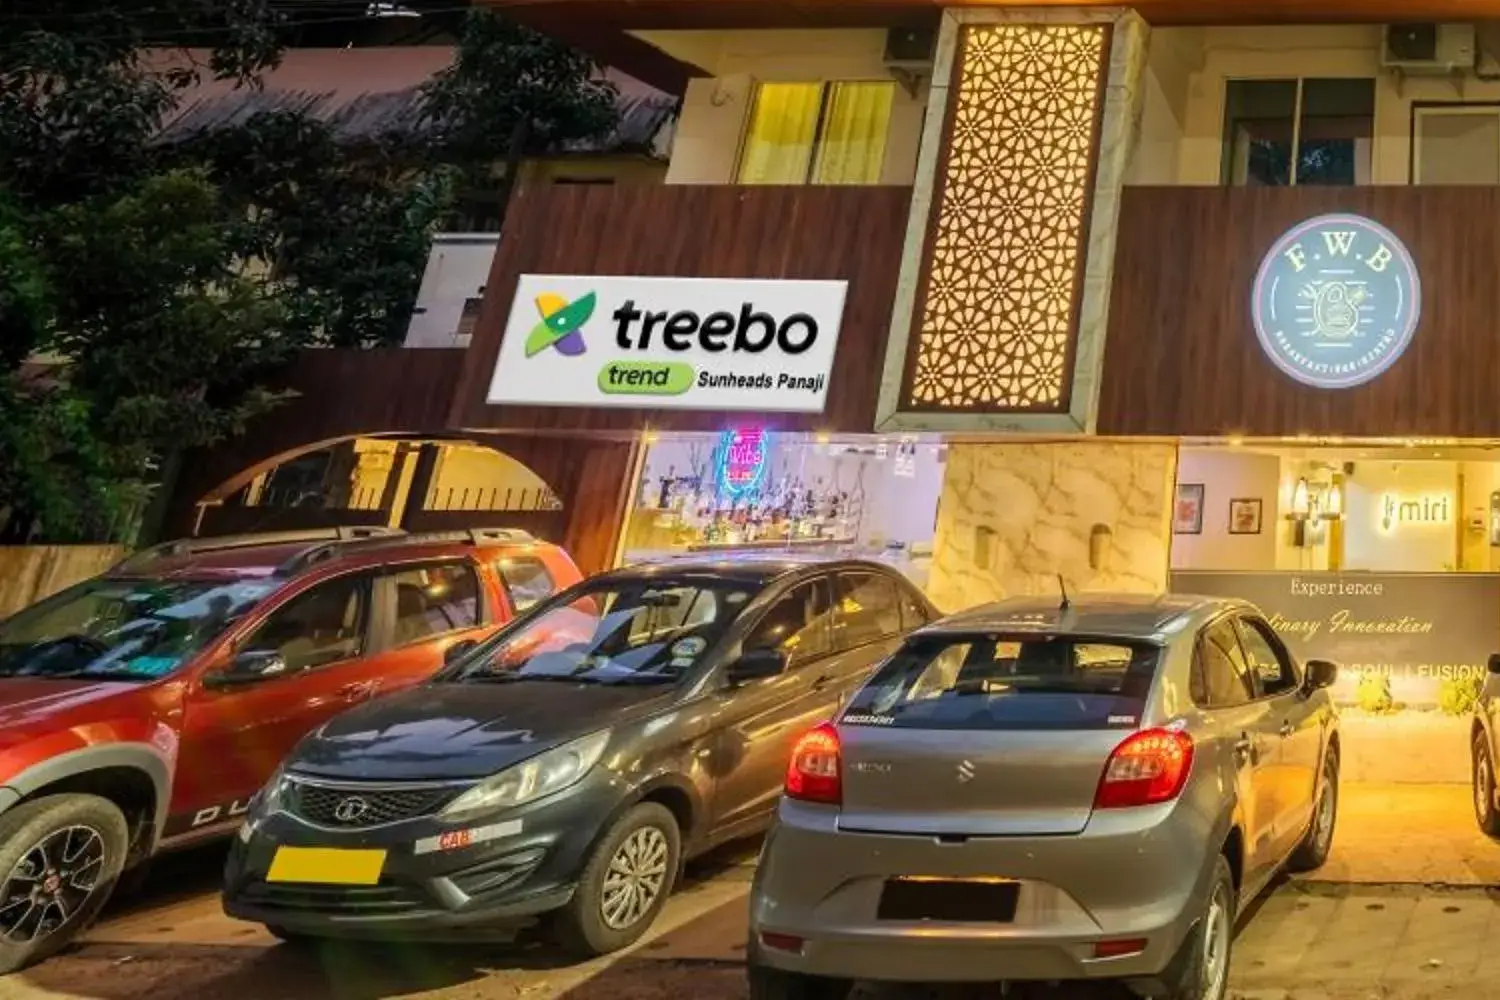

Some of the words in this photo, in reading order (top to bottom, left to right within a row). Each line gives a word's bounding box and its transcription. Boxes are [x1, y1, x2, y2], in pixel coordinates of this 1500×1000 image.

[612, 299, 819, 355] treebo
[608, 364, 671, 387] trend
[697, 370, 773, 390] Sunheads
[777, 372, 825, 394] Panaji
[1290, 577, 1383, 597] Experience
[1417, 664, 1486, 682] FUSION
